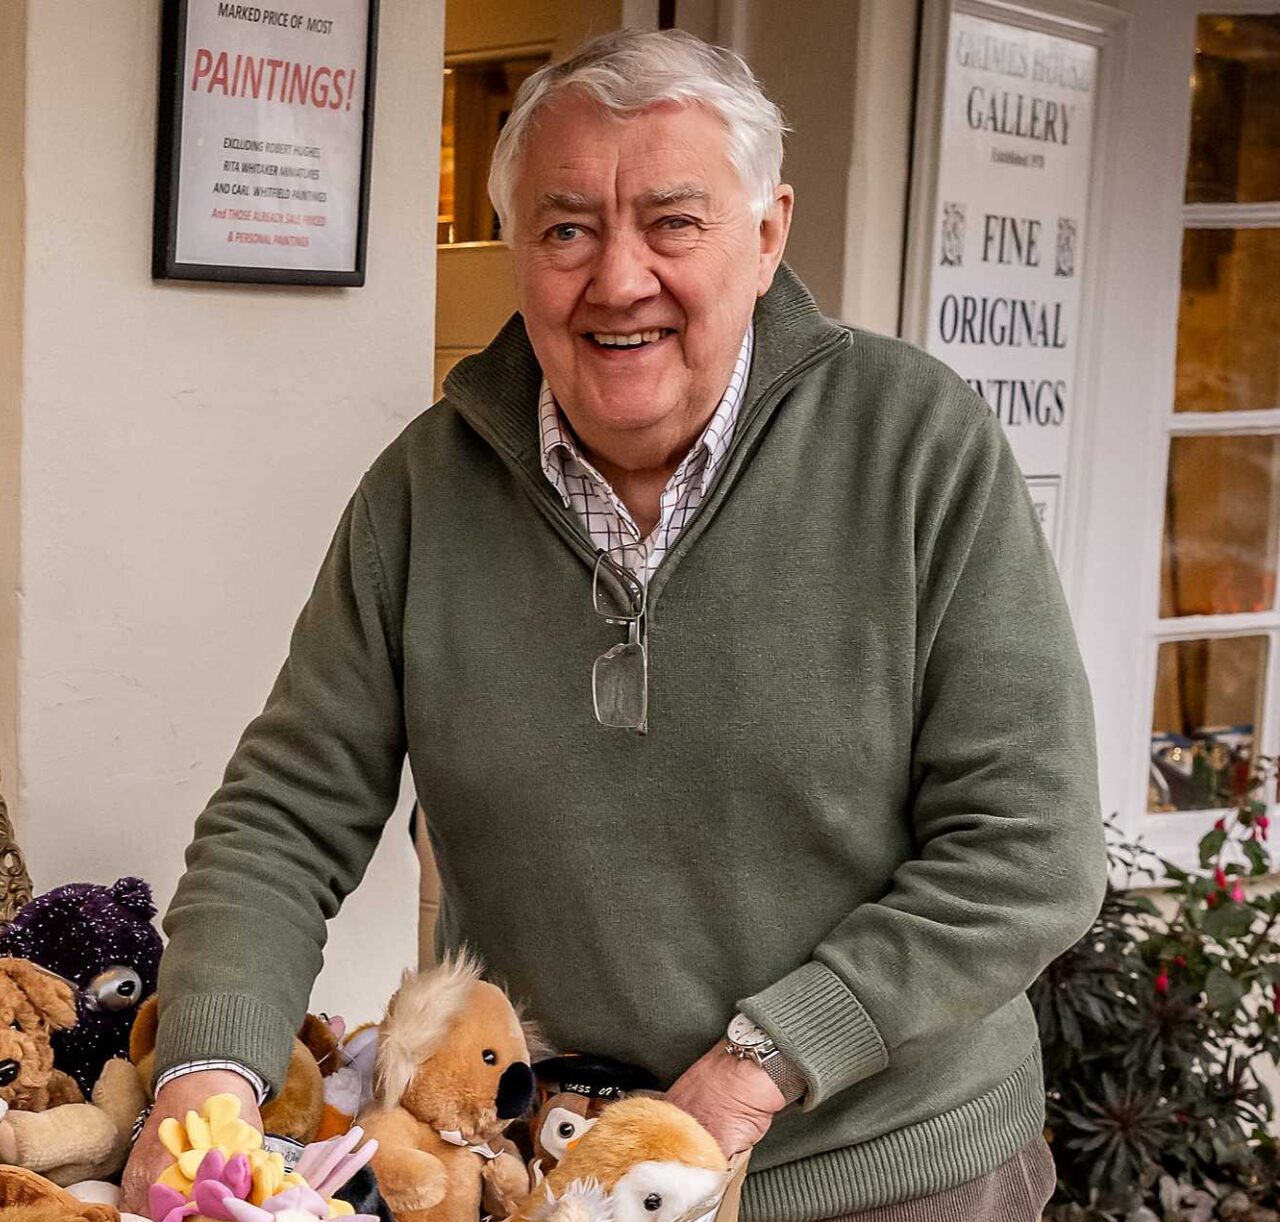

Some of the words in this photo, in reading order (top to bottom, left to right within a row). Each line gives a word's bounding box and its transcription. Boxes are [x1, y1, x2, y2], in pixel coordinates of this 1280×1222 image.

[218, 3, 261, 23] MARKED
[263, 10, 288, 27] PRICE
[291, 15, 303, 29] OF
[307, 17, 333, 34] MOST
[192, 49, 355, 111] PAINTINGS!
[967, 86, 1075, 145] GALLERY
[223, 137, 264, 152] EXCLUDING
[223, 160, 240, 172] RITA
[241, 162, 278, 175] WHITAKER
[213, 183, 230, 194] AND
[231, 184, 249, 196] CARL
[253, 186, 290, 199] WHITFIELD
[228, 209, 253, 220] THOSE
[235, 232, 271, 245] PERSONAL
[981, 214, 1042, 267] FINE
[940, 294, 1066, 348] ORIGINAL
[966, 379, 1066, 426] TINGS
